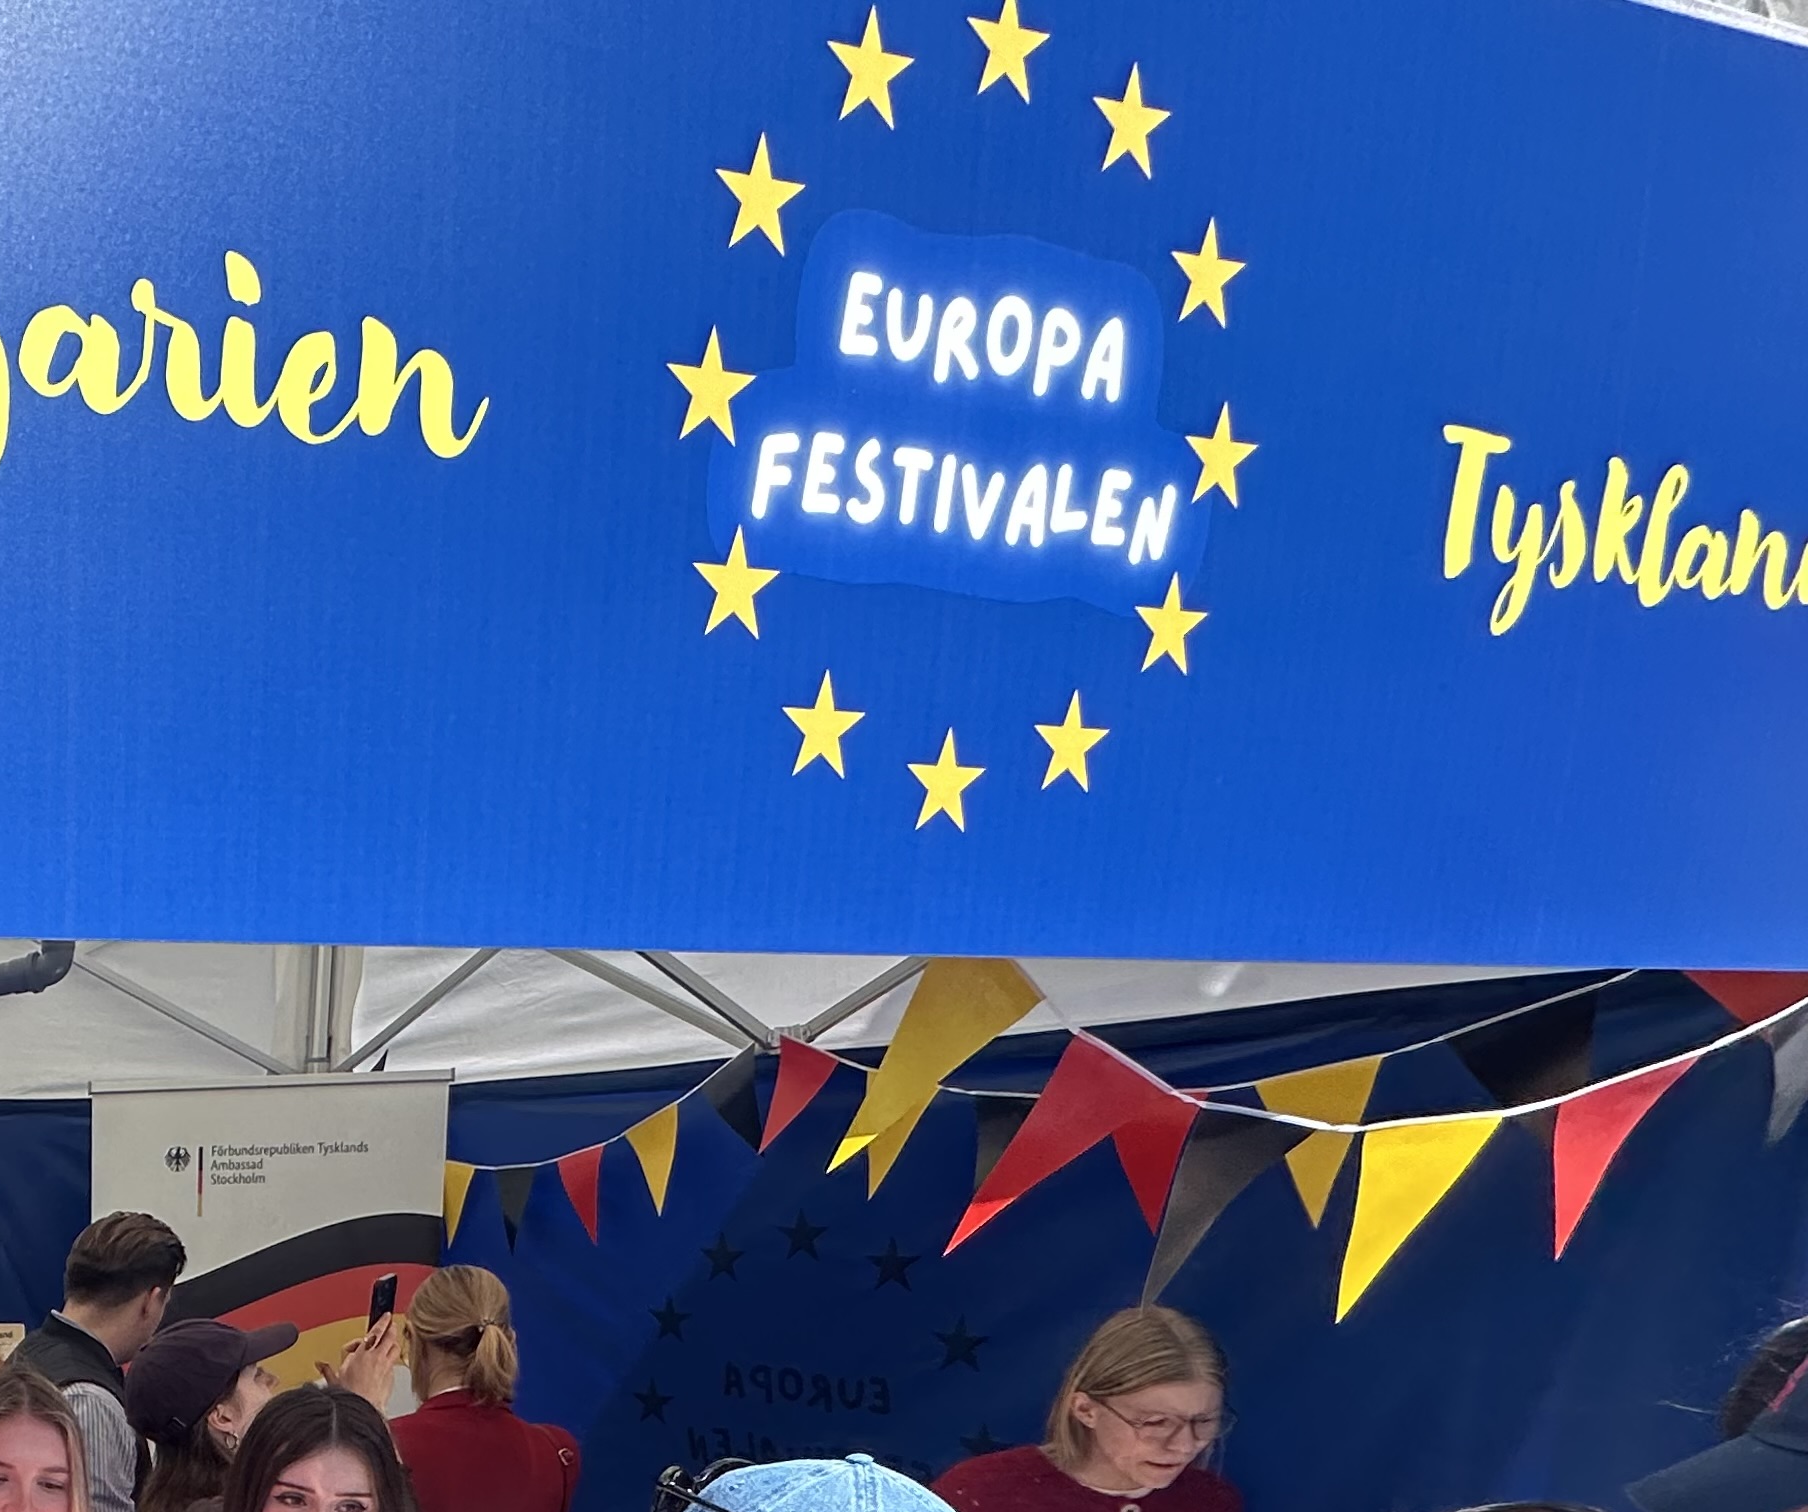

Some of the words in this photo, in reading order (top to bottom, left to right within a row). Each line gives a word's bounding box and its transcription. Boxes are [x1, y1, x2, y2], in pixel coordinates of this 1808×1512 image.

[839, 270, 1127, 402] EUROPA
[749, 430, 1179, 565] FESTIVALEN
[1443, 424, 1808, 636] Tysklan
[210, 1158, 263, 1171] Ambassad
[210, 1173, 266, 1185] Stockholm
[211, 1145, 315, 1157] Förbundsrepubliken
[317, 1142, 369, 1155] Tysklands
